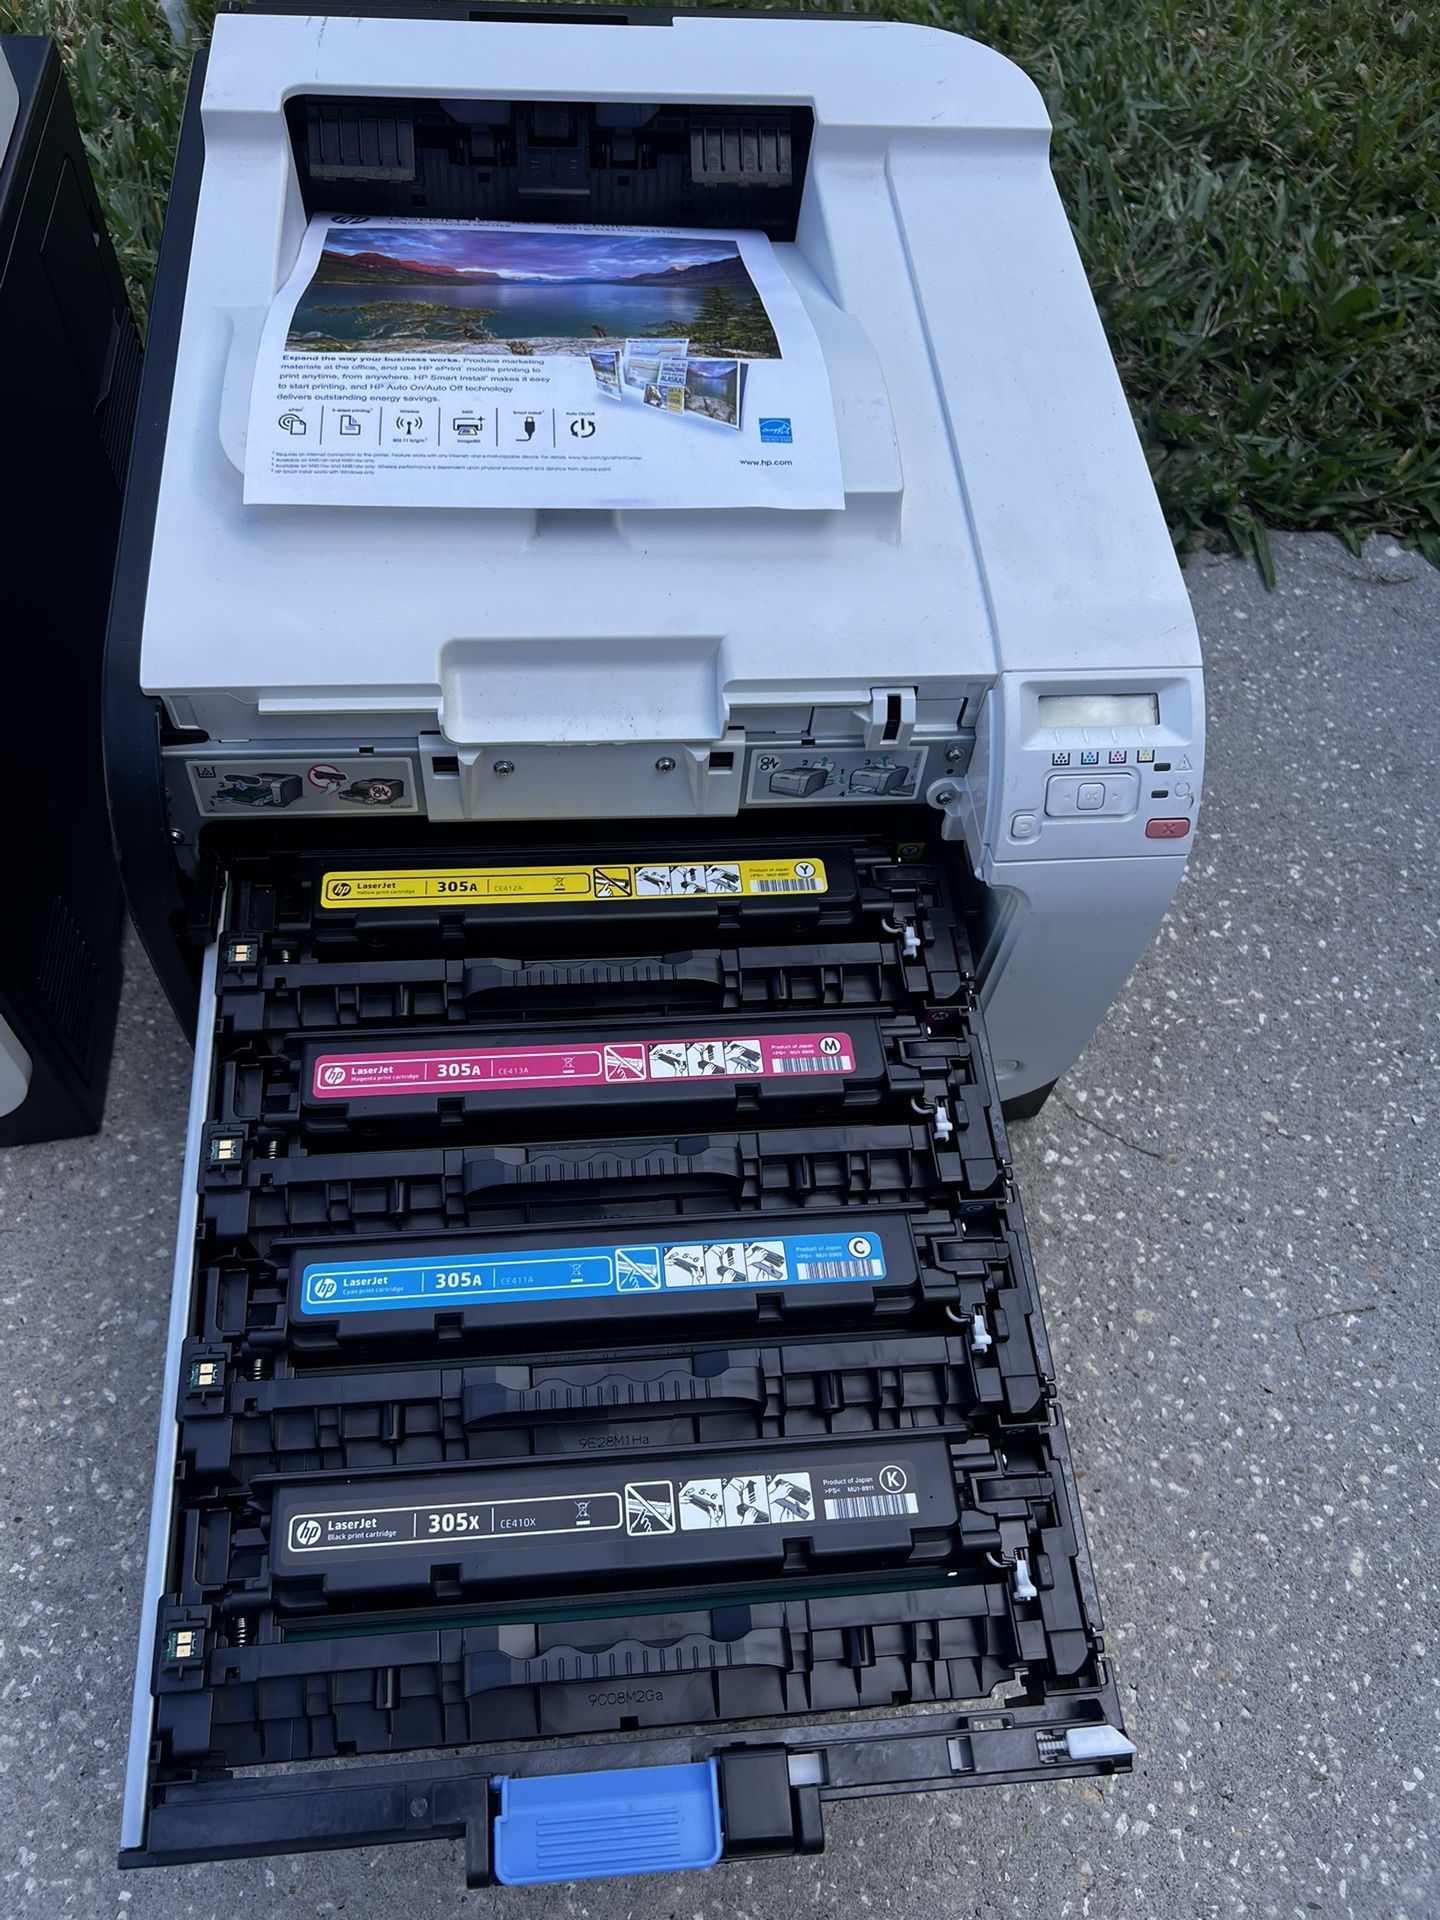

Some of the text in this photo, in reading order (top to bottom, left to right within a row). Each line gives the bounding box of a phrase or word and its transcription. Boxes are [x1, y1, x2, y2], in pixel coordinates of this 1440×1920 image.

[314, 394, 367, 402] outstanding
[800, 865, 809, 875] Y
[332, 882, 351, 897] hp
[357, 882, 397, 890] LaserJet
[437, 880, 478, 892] 305A
[824, 1040, 838, 1051] M
[324, 1066, 346, 1085] hp
[351, 1066, 394, 1076] LaserJet
[437, 1063, 481, 1077] 305A
[498, 1067, 529, 1075] CE413A
[351, 1075, 377, 1083] Magenta
[391, 1073, 420, 1081] cartridge
[853, 1240, 865, 1254] C
[343, 1276, 388, 1287] LaserJet
[435, 1271, 482, 1289] 305A
[500, 1276, 534, 1286] CE411A
[314, 1277, 338, 1299] hp
[342, 1286, 405, 1296] Cyan print cartridge
[578, 1434, 650, 1448] 9E28M1Ha
[823, 1478, 846, 1486] Product
[854, 1477, 873, 1485] Japan
[886, 1471, 900, 1487] K
[327, 1517, 378, 1531] LaserJet
[500, 1517, 536, 1529] CE410X
[296, 1519, 321, 1545] hp
[327, 1529, 397, 1541] Black print cartridge
